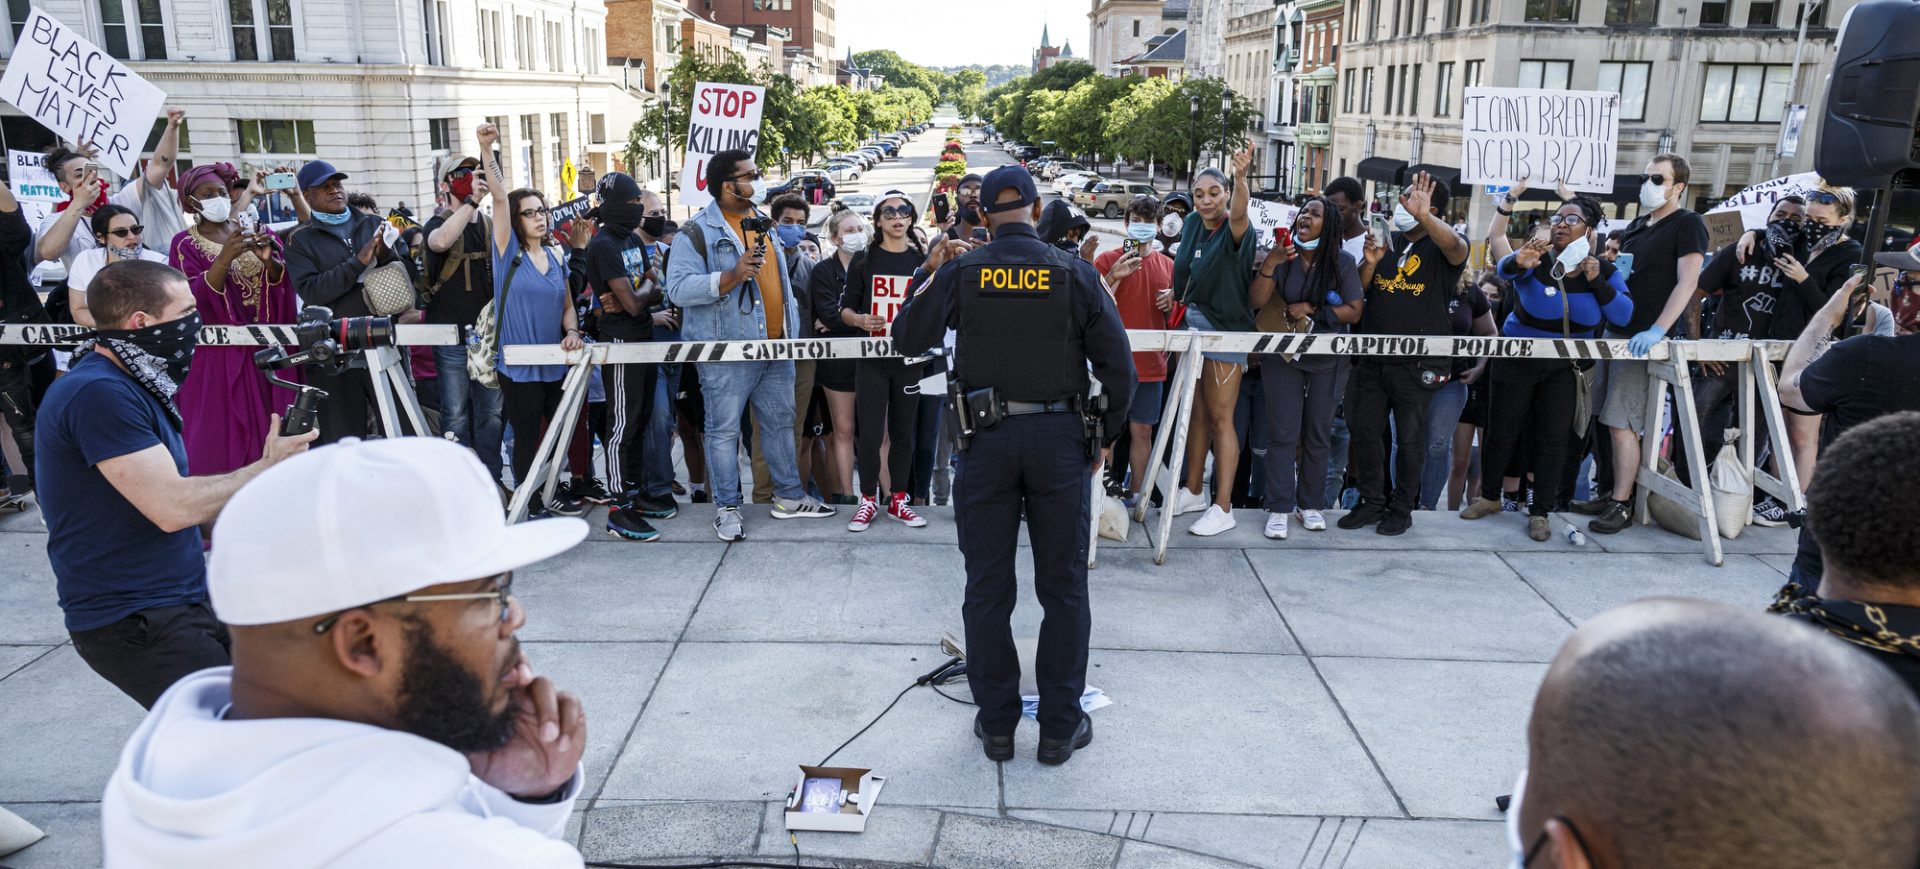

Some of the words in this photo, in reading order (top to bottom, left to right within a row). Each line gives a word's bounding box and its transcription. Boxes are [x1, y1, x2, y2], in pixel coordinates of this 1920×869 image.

[32, 15, 127, 100] BLACK
[46, 56, 121, 125] LIVES
[698, 88, 757, 118] STOP
[16, 72, 130, 167] MATTER
[687, 123, 758, 156] KILLING
[1466, 138, 1531, 182] ACAB
[19, 183, 63, 198] MATTER
[1250, 198, 1266, 210] HIS
[1260, 217, 1278, 227] WHY
[1712, 223, 1733, 234] NOT
[980, 268, 1050, 290] POLICE
[742, 341, 837, 360] CAPITOL
[1330, 336, 1430, 355] CAPITOL
[1451, 338, 1534, 357] POLICE
